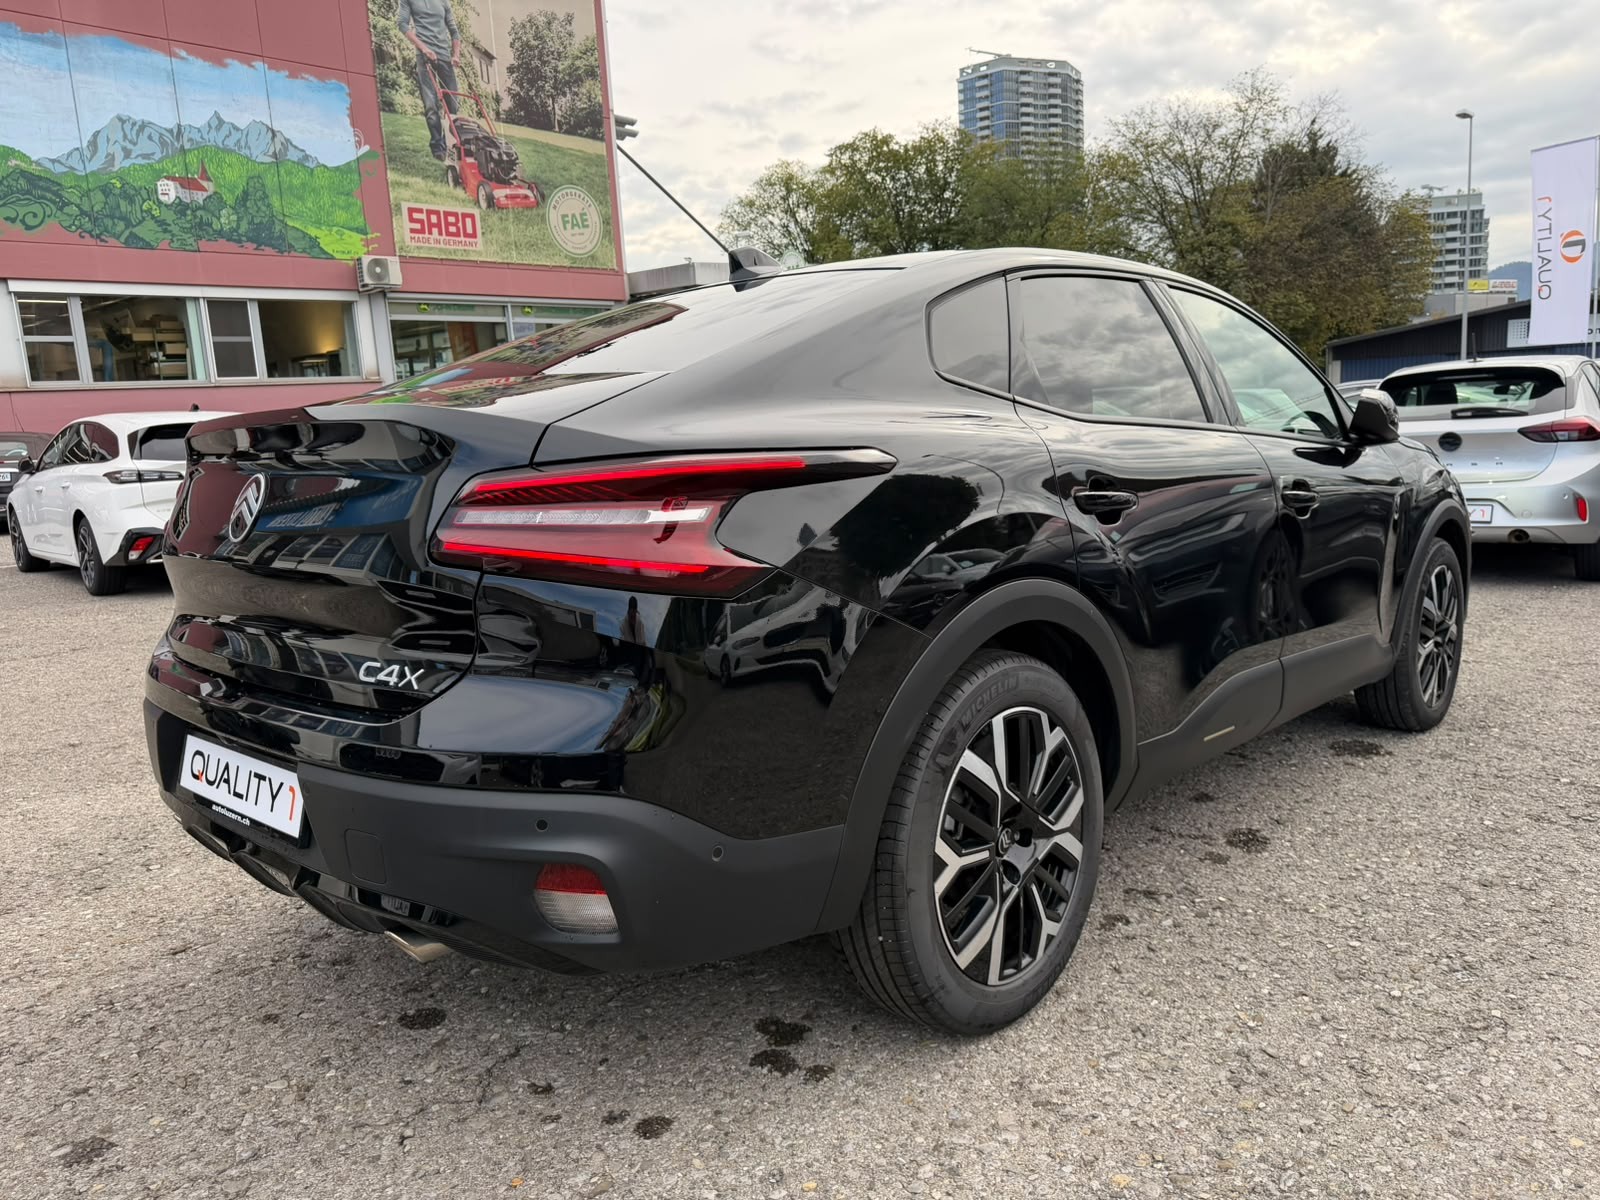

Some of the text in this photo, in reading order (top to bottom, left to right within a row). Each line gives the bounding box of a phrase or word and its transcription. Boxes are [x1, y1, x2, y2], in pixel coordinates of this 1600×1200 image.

[407, 207, 478, 239] SABO
[560, 207, 591, 231] FAÉ
[410, 235, 479, 248] MADE IN GERMANY
[962, 675, 1019, 730] MICHELIN
[211, 803, 251, 827] autoluzern.ch
